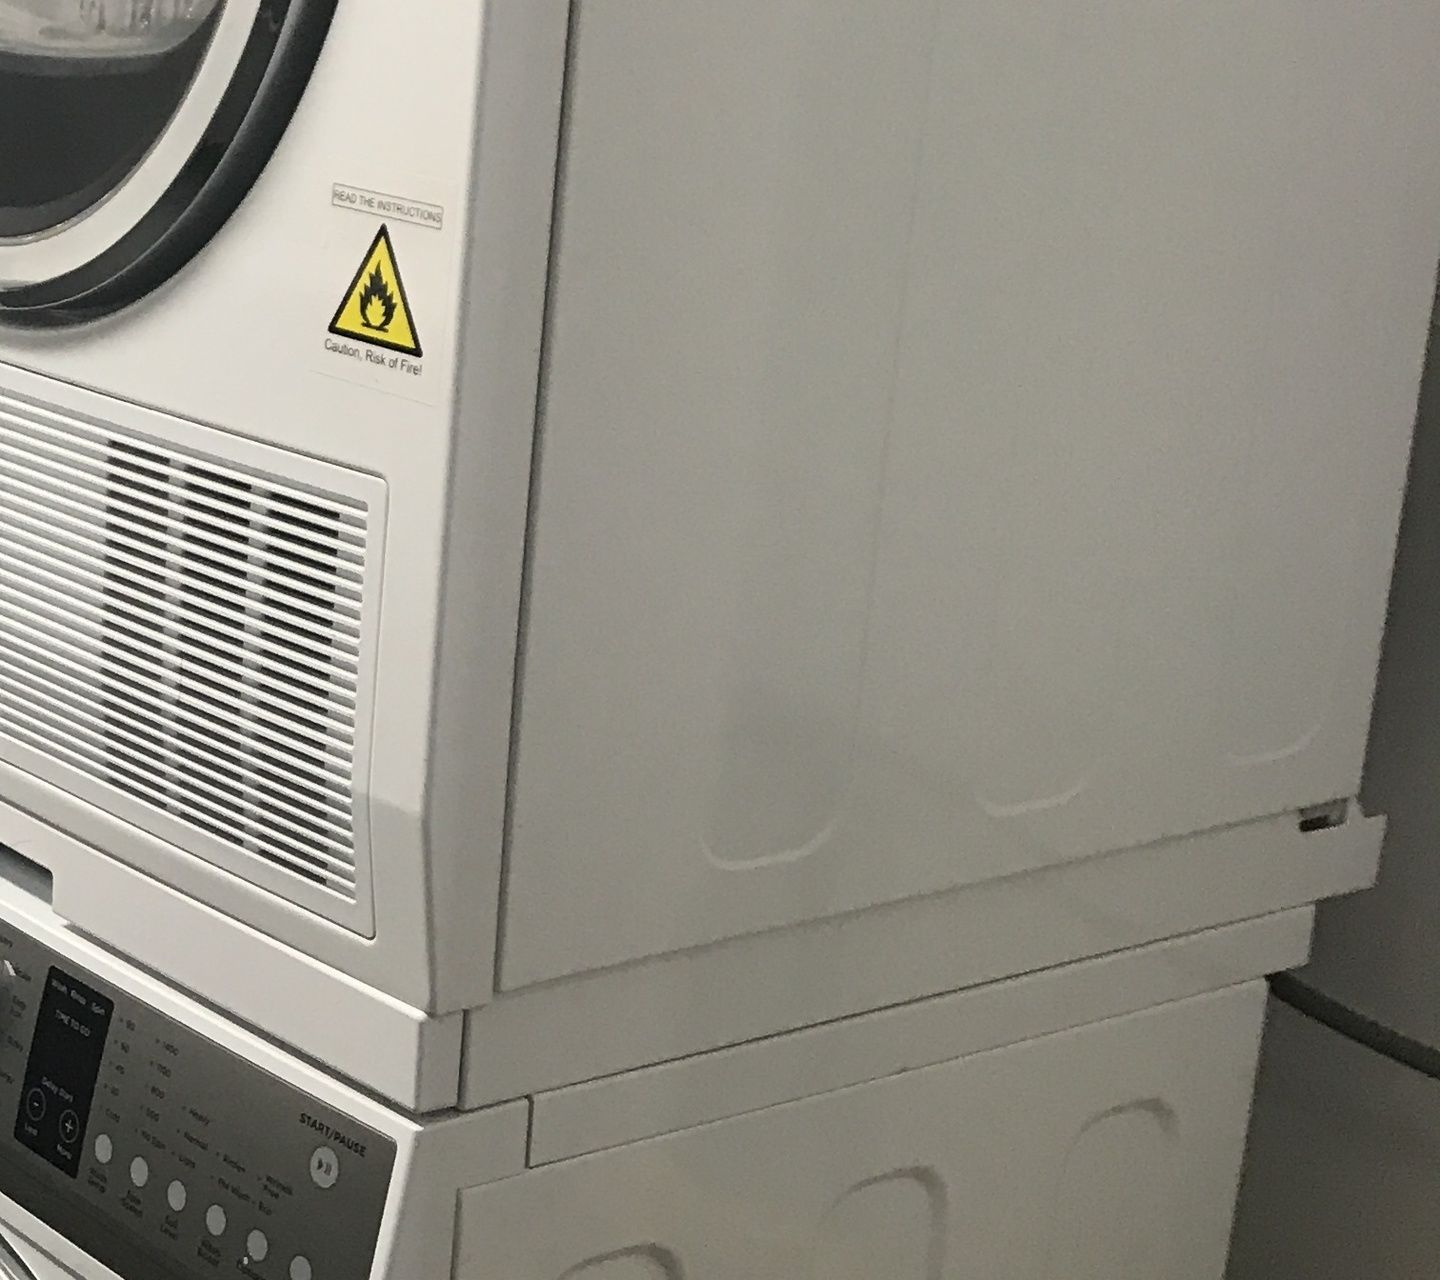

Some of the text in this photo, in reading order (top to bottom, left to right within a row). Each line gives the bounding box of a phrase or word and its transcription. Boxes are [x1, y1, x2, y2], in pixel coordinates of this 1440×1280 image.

[333, 189, 443, 224] READ THE INSTRUCTIONS
[324, 338, 422, 376] Caution, Risk of Fire!
[299, 1112, 367, 1158] START/PAUSE
